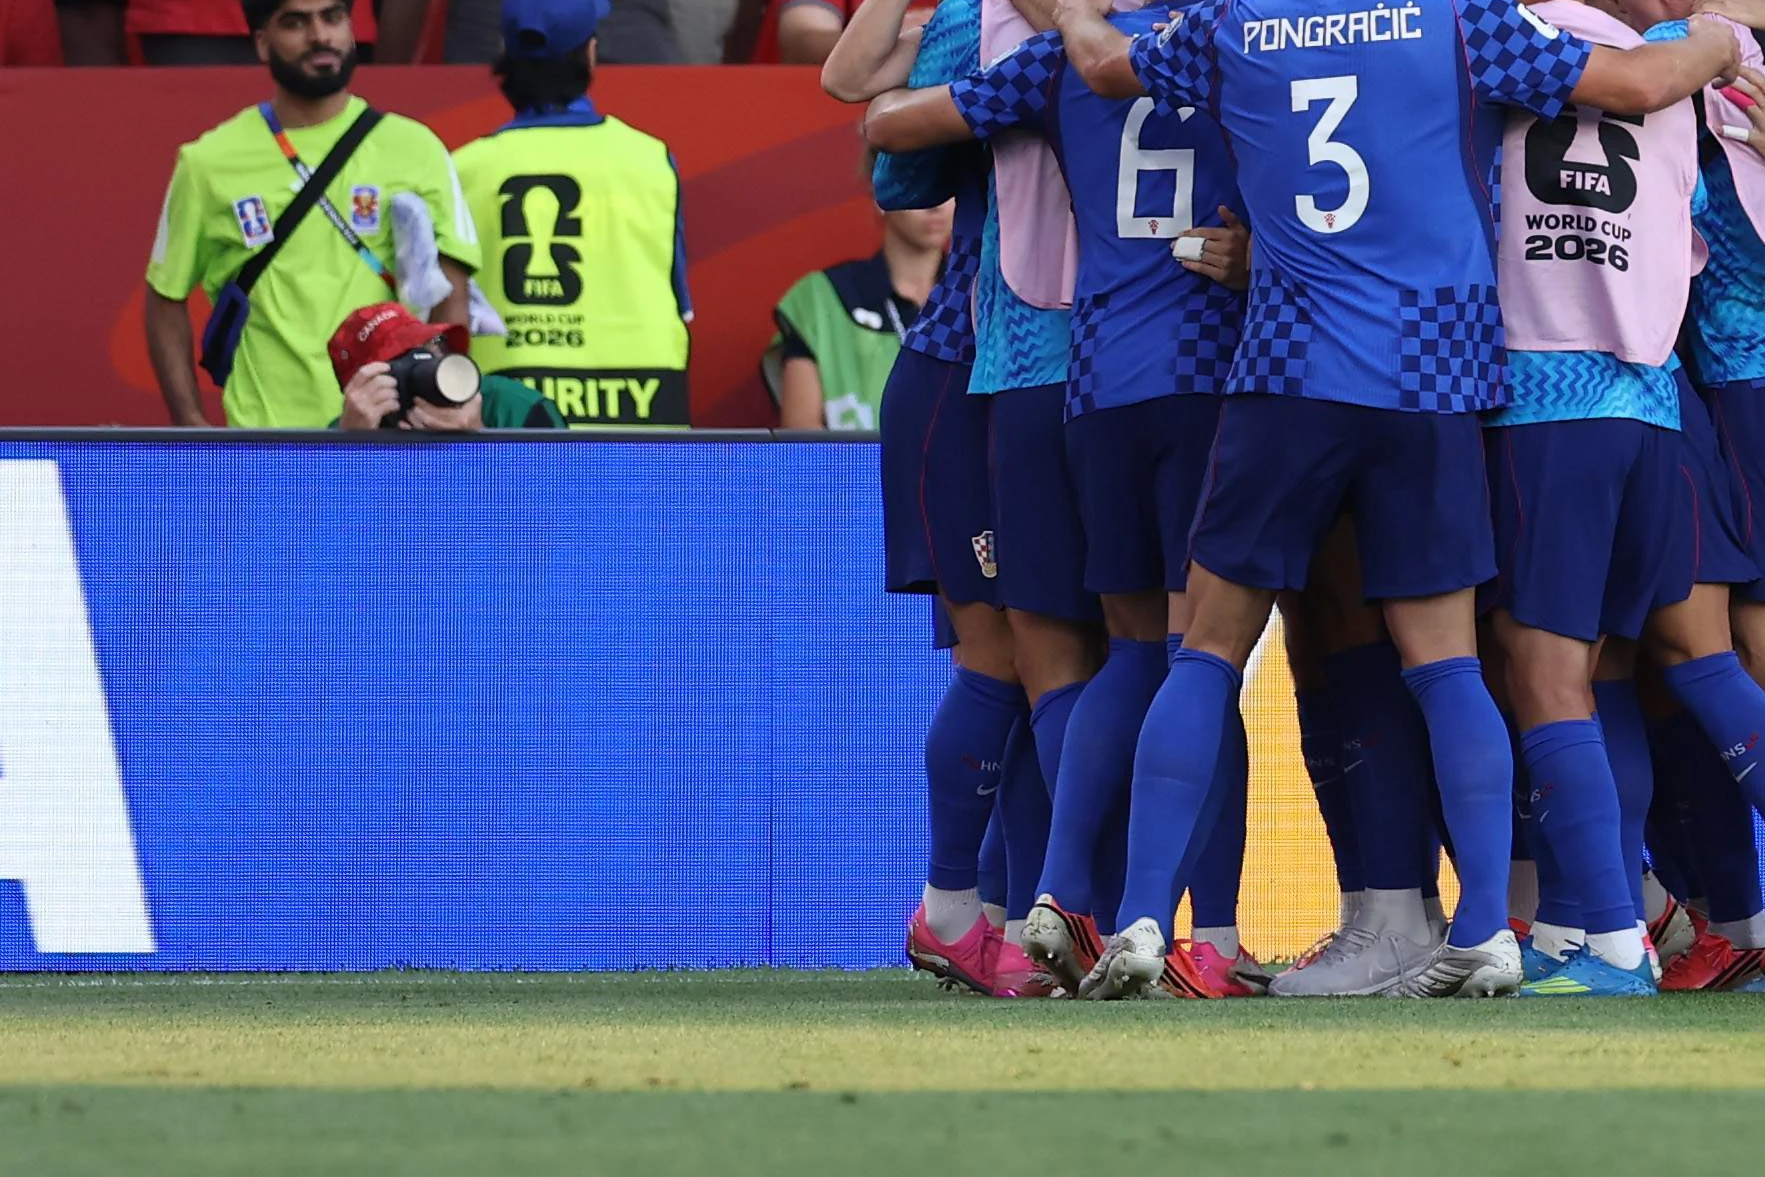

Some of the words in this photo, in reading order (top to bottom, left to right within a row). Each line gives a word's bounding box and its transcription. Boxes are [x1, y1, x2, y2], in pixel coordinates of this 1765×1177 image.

[1116, 96, 1196, 239] 6
[1290, 75, 1371, 234] 3
[1559, 169, 1612, 196] FIFA
[1525, 213, 1598, 232] WORLD
[1600, 220, 1632, 243] CUP
[1524, 234, 1629, 272] 2026
[523, 278, 565, 298] FIFA
[358, 309, 398, 342] CANADA
[505, 329, 585, 349] 2026
